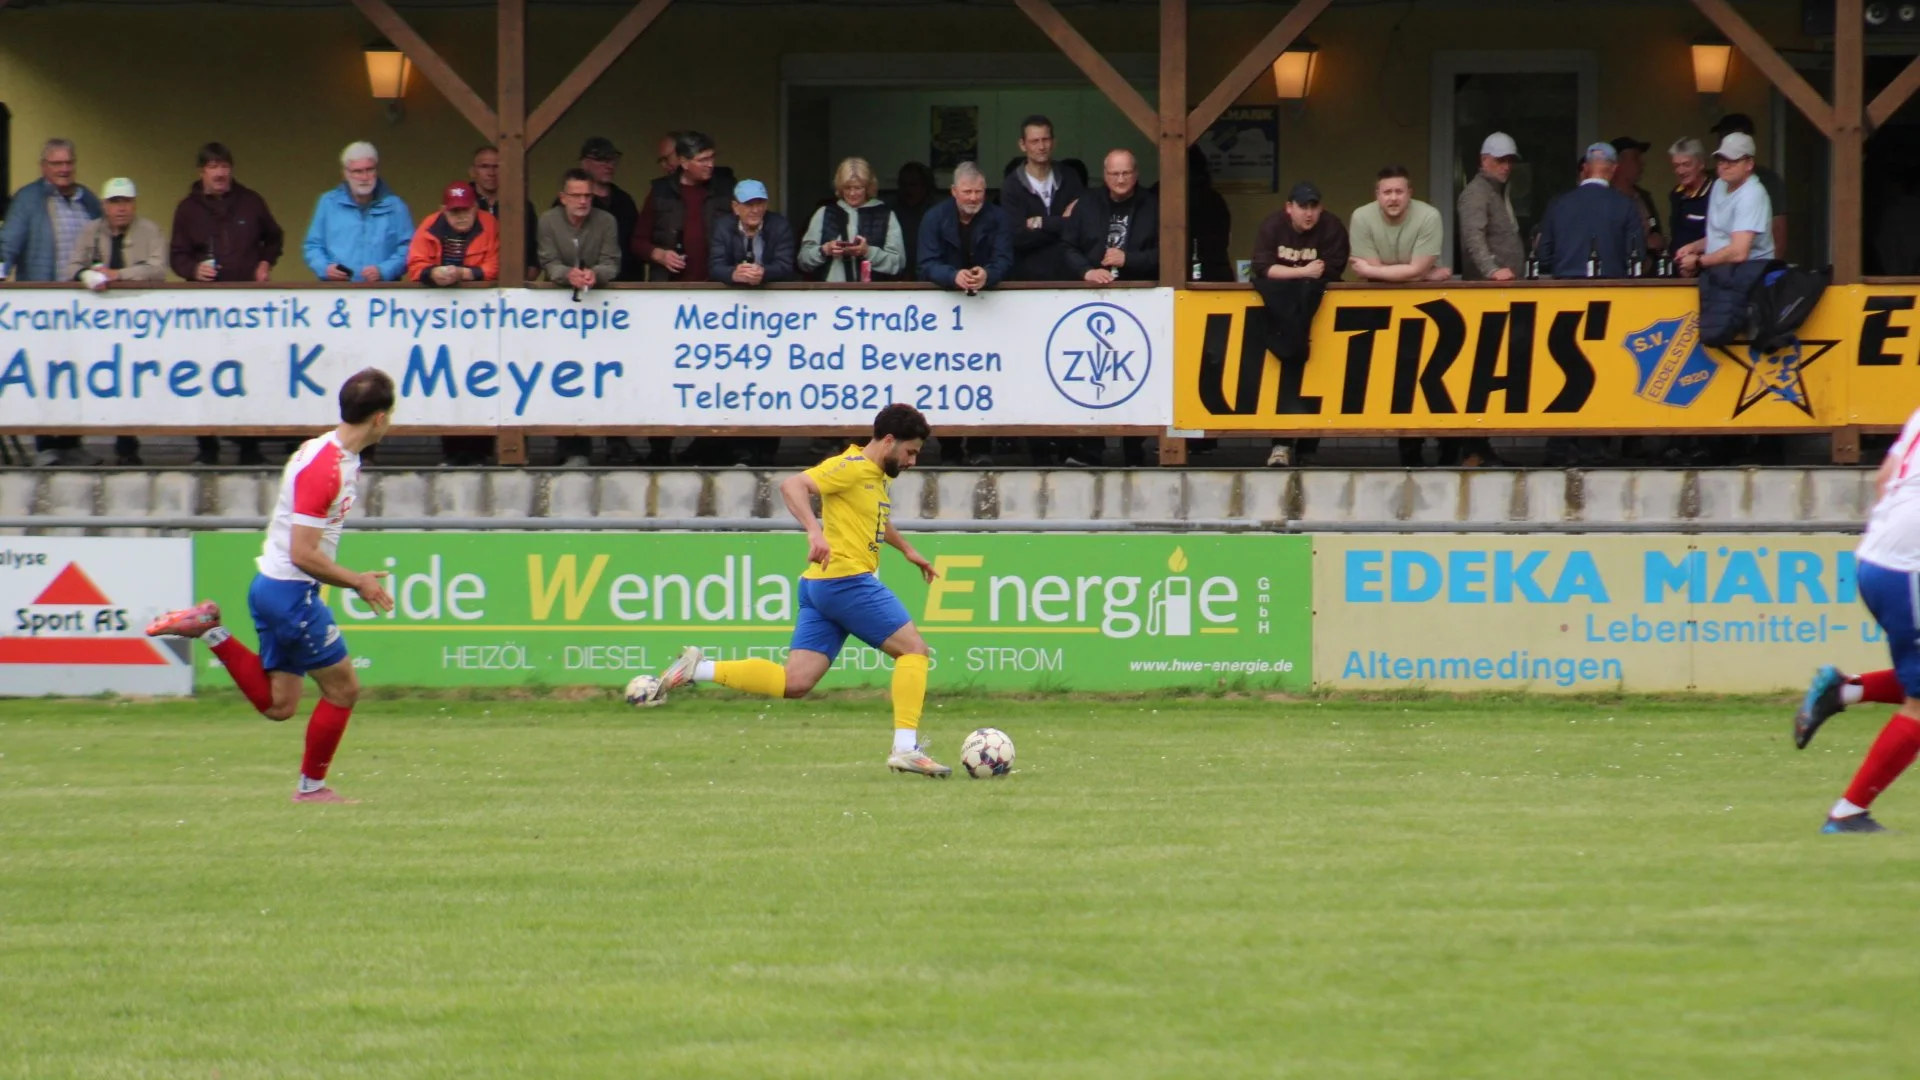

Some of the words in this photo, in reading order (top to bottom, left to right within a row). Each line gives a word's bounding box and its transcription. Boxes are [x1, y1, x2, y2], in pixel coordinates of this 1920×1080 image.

[328, 298, 350, 328] &
[368, 297, 630, 339] Physiotherapie
[674, 303, 818, 338] Medinger
[832, 304, 938, 331] Straße
[951, 305, 964, 331] 1
[673, 343, 772, 370] 29549
[789, 344, 845, 371] Bad
[861, 345, 1002, 372] Bevensen
[1198, 299, 1612, 414] ULTRAS
[1632, 331, 1669, 352] S.V.
[0, 343, 246, 399] Andrea
[401, 344, 624, 416] Meyer
[1062, 350, 1136, 381] ZVK
[673, 382, 792, 411] Telefon
[800, 384, 894, 410] 05821
[916, 384, 994, 411] 2108
[320, 554, 486, 620] eide
[527, 554, 879, 621] Wendla
[1344, 551, 1612, 603] EDEKA
[16, 608, 84, 635] Sport
[1257, 577, 1270, 634] GmbH
[1585, 613, 1849, 643] Lebensmittel-
[443, 641, 536, 669] HEIZÖL
[564, 646, 656, 669] DIESEL
[967, 647, 1063, 670] STROM
[1130, 659, 1293, 674] www.hwe-energie.de
[1341, 651, 1622, 686] Altenmedingen
